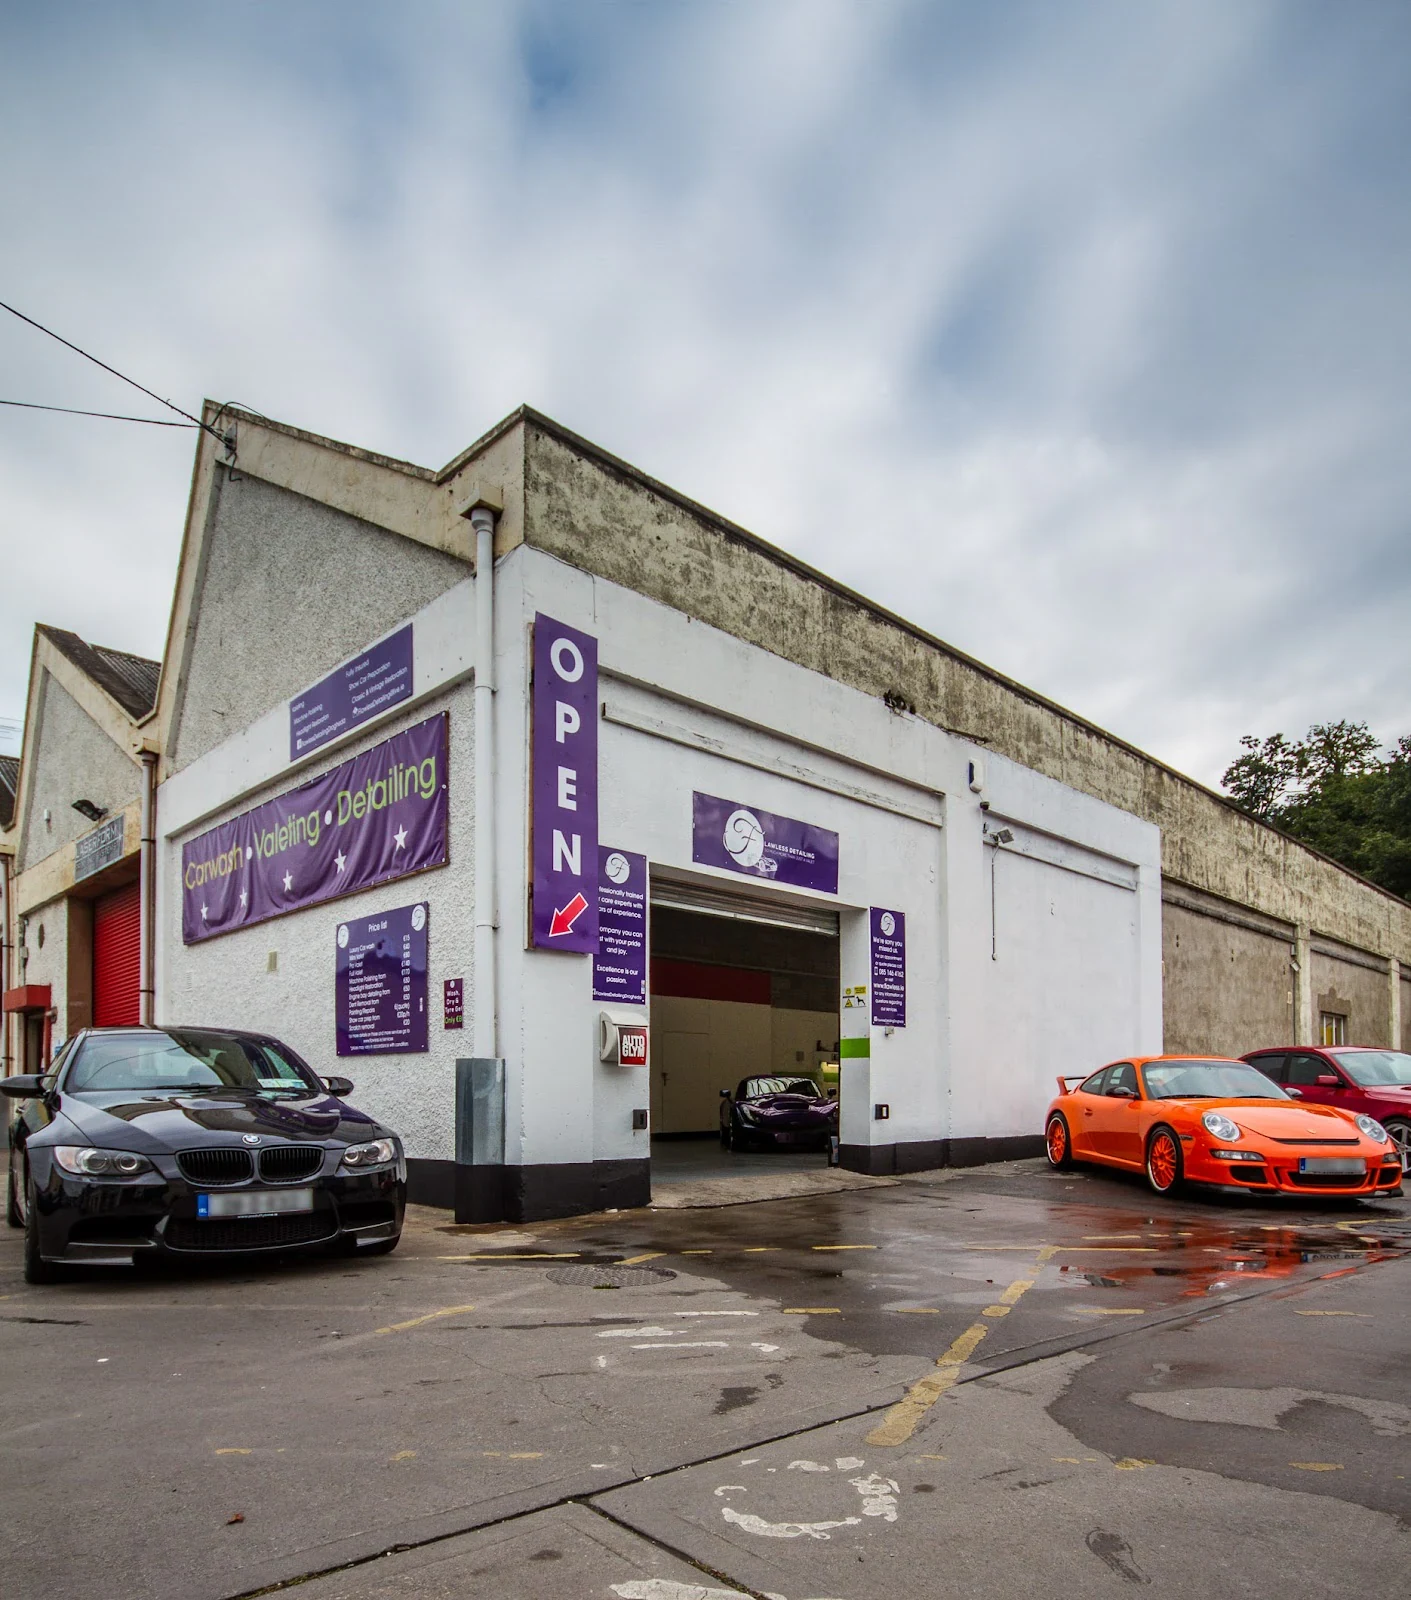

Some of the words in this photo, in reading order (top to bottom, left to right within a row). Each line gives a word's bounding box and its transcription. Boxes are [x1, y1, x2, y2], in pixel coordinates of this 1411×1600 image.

[346, 668, 354, 678] Fully
[349, 681, 359, 691] Show
[367, 662, 390, 680] Preparation
[352, 692, 365, 704] Classic
[369, 681, 384, 693] Vintage
[385, 667, 407, 684] Restoration
[312, 713, 329, 727] Restoration
[550, 638, 584, 876] OPEN
[185, 842, 244, 890] Carwash
[254, 810, 320, 860] Valeting
[337, 756, 436, 826] Detailing
[764, 841, 788, 853] LAWLESS
[789, 848, 815, 860] DETAILING
[626, 891, 643, 900] trained
[601, 897, 613, 905] care
[614, 899, 632, 908] experts
[613, 908, 642, 919] experience.
[368, 923, 381, 933] Price
[600, 926, 621, 936] ompany
[622, 929, 632, 937] you
[873, 936, 884, 945] We're
[885, 939, 894, 947] sorry
[618, 948, 628, 956] joy.
[879, 945, 892, 953] missed
[597, 964, 624, 974] Excellence
[625, 967, 630, 975] is
[606, 976, 627, 984] passion.
[446, 998, 455, 1006] Dry
[445, 1006, 455, 1014] Tyre
[622, 1034, 645, 1046] AUTO
[622, 1045, 645, 1058] GLYM
